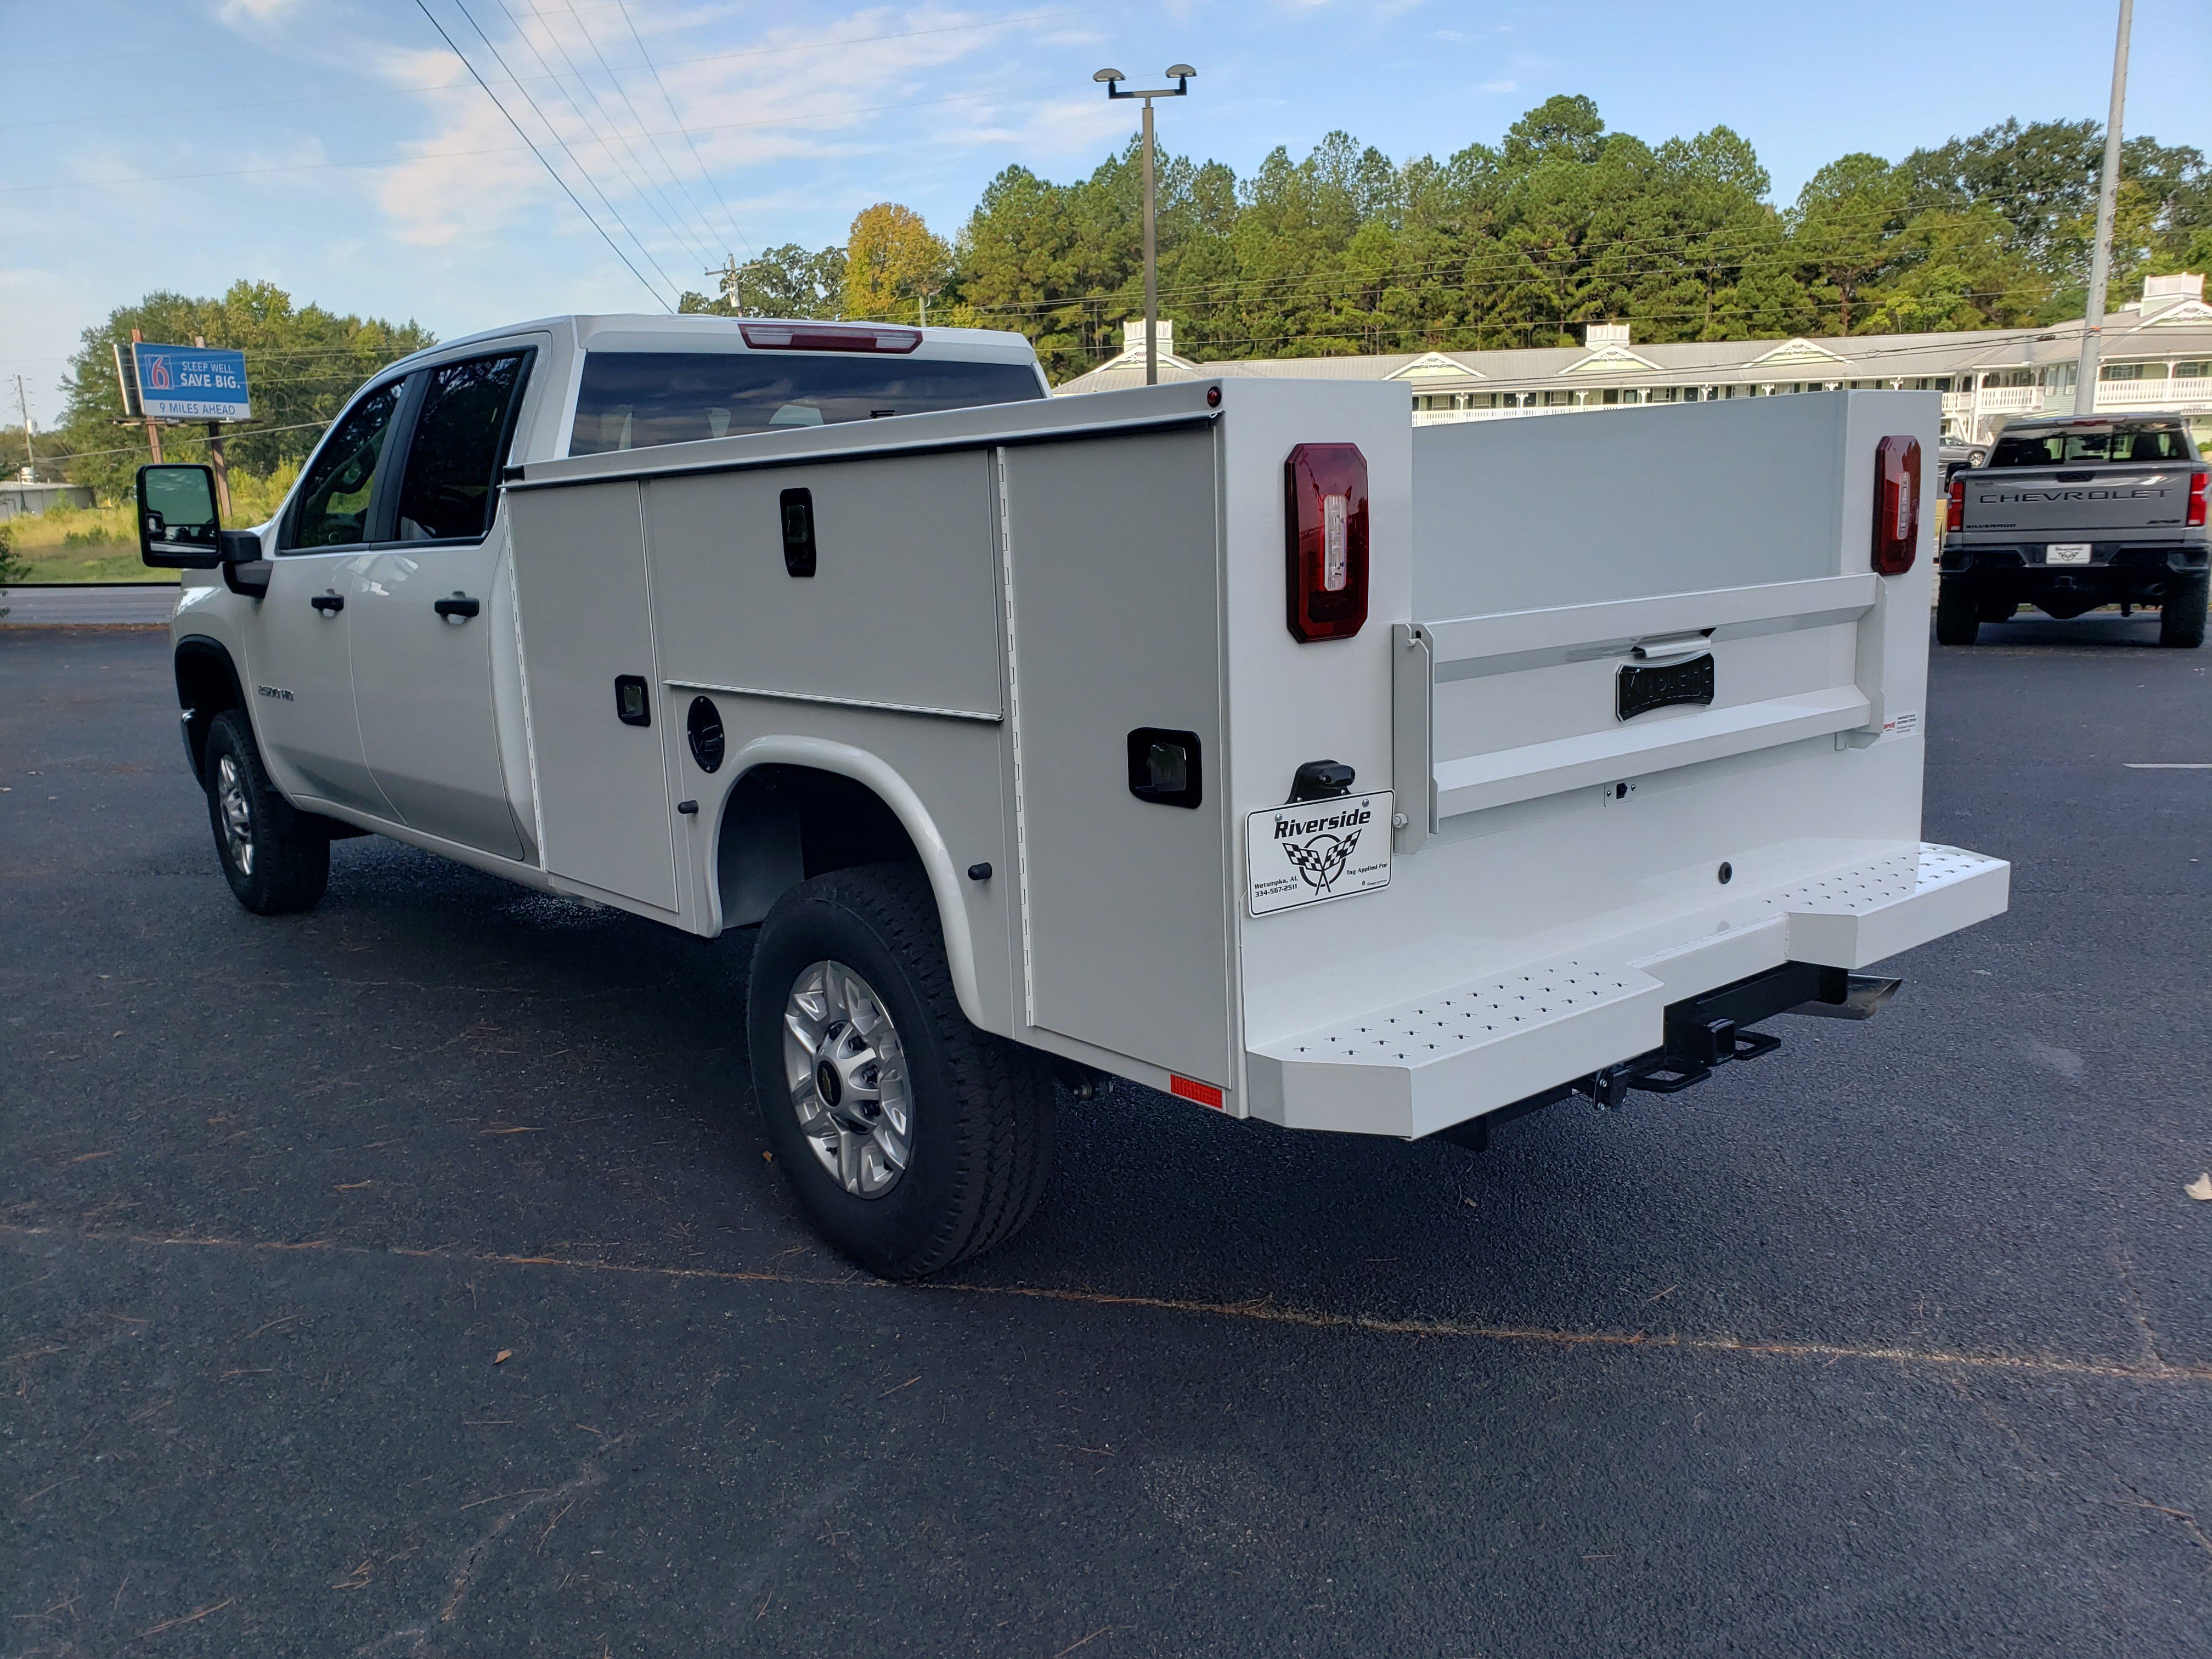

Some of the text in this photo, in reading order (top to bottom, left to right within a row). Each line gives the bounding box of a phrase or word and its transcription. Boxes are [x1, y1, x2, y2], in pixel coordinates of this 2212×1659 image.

[151, 356, 170, 390] 6
[182, 361, 235, 374] SLEEP WELL.
[180, 373, 240, 389] SAVE BIG.
[159, 402, 235, 415] 9 MILES AHEAD
[1979, 488, 2173, 504] CHEVROLET
[1273, 808, 1371, 839] Riverside
[1357, 864, 1378, 873] Applied
[1254, 879, 1288, 889] Wetumpka,
[1255, 883, 1297, 898] 334-567-2511
